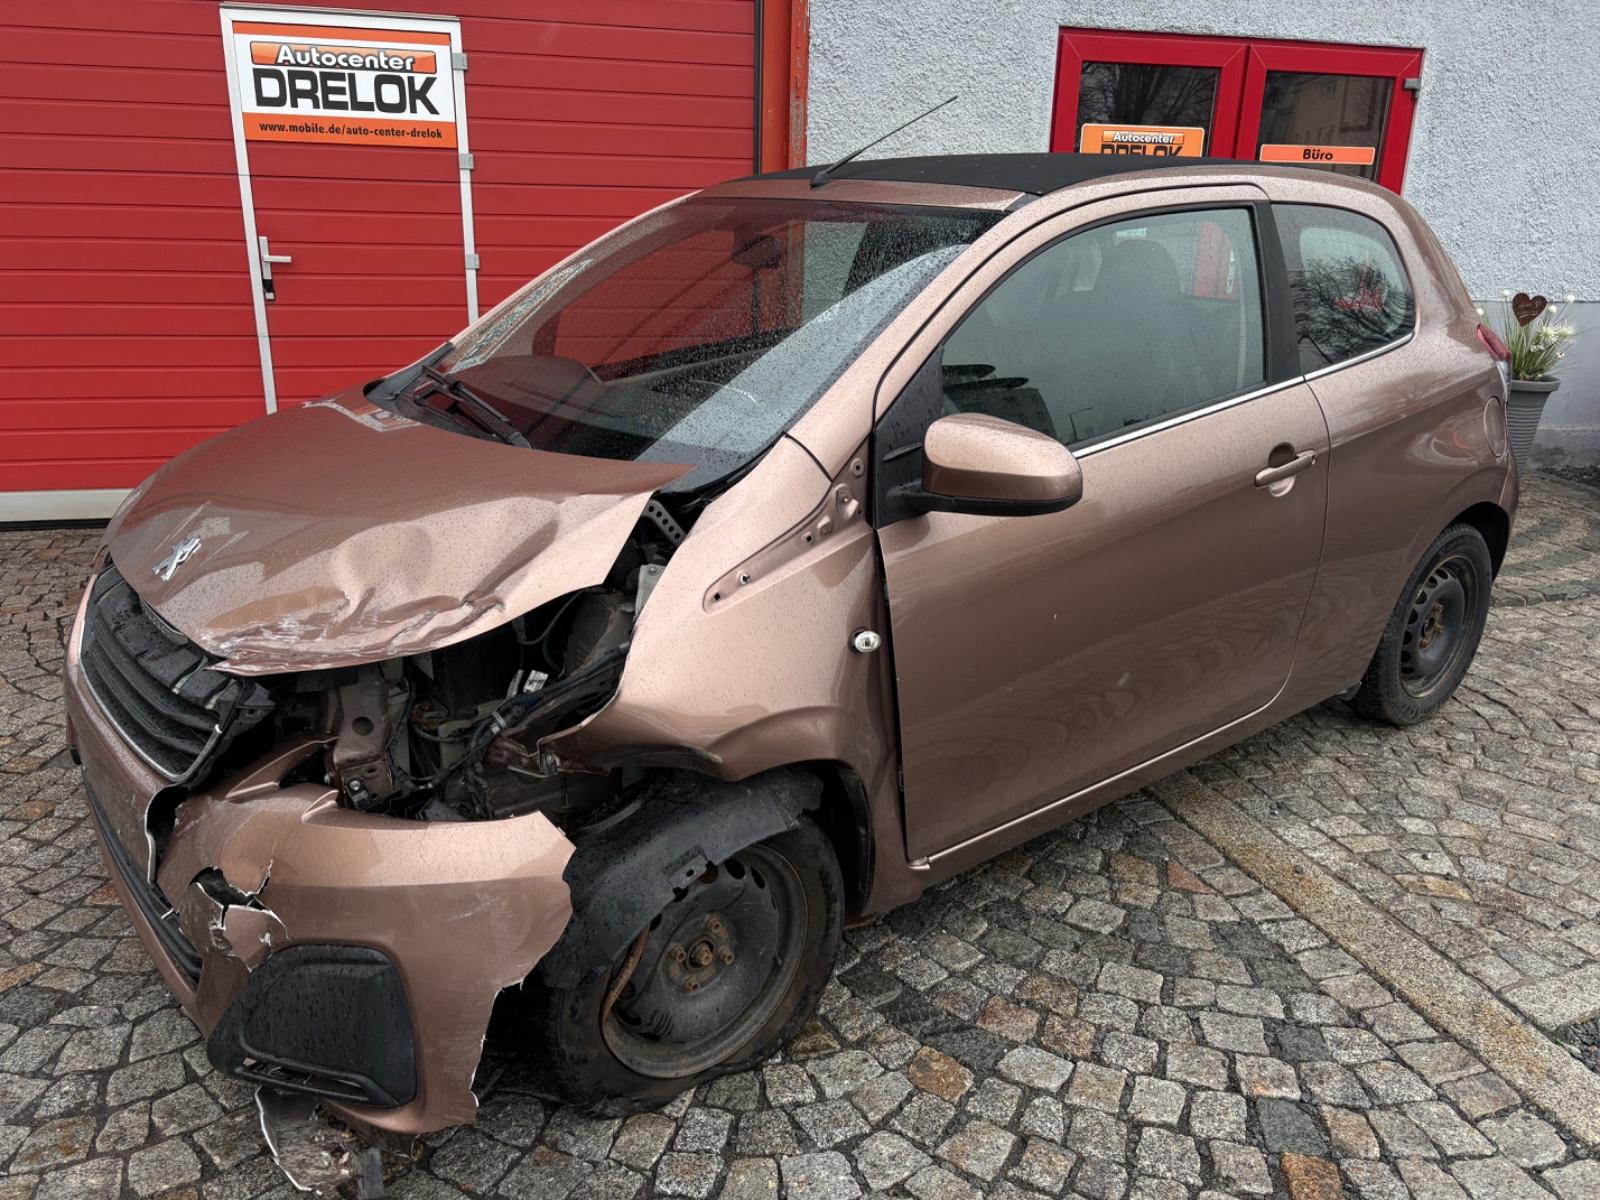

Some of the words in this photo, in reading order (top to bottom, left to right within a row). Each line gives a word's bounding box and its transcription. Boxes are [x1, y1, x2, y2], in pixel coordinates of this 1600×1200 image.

[276, 45, 415, 71] Autocenter
[252, 67, 440, 115] DRELOK
[259, 121, 442, 139] www.mobile.de/auto-center-drelok
[1113, 131, 1175, 144] Autocenter
[1302, 148, 1334, 160] Büro
